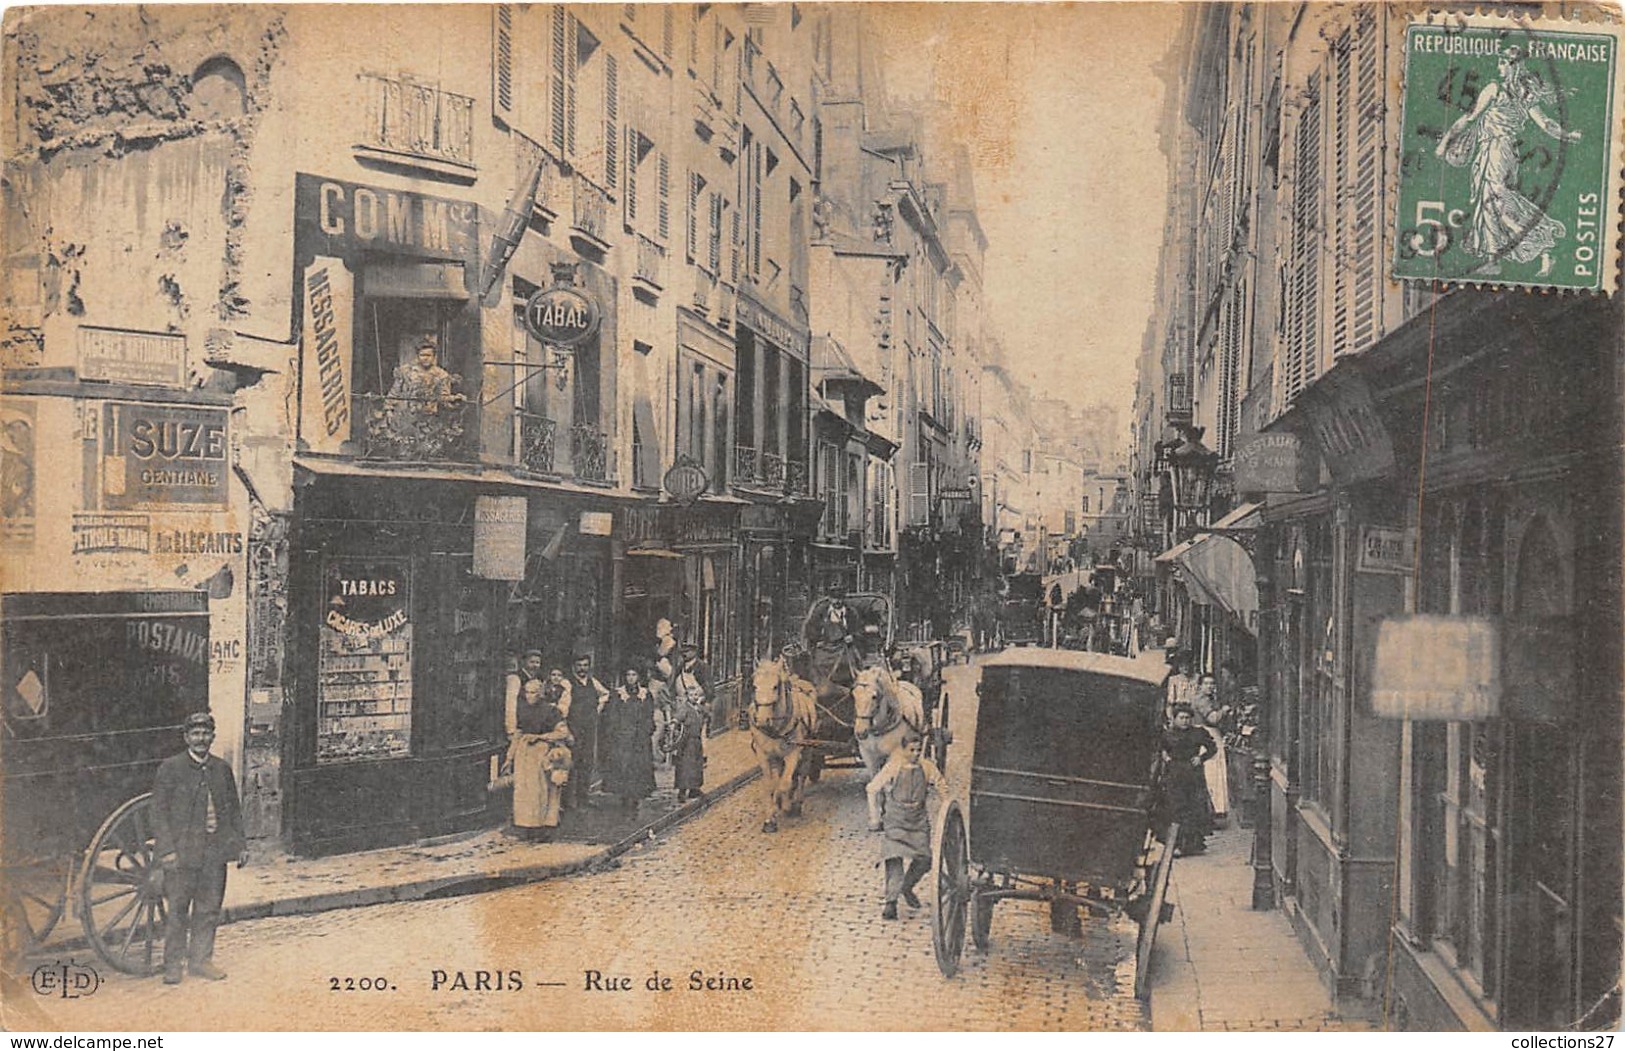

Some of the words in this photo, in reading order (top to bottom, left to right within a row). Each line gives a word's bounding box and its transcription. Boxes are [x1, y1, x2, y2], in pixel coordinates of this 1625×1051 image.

[1528, 41, 1607, 63] FRANÇAISE
[1575, 192, 1597, 276] POSTES
[534, 303, 587, 329] TABAC
[307, 267, 348, 437] MESSAGERIES
[131, 419, 226, 460] SUZE
[141, 469, 218, 486] GENTIANE
[340, 580, 396, 596] TABACS
[326, 610, 370, 637] CIGARES
[379, 609, 407, 633] LUXE
[126, 620, 207, 665] POSTAUX
